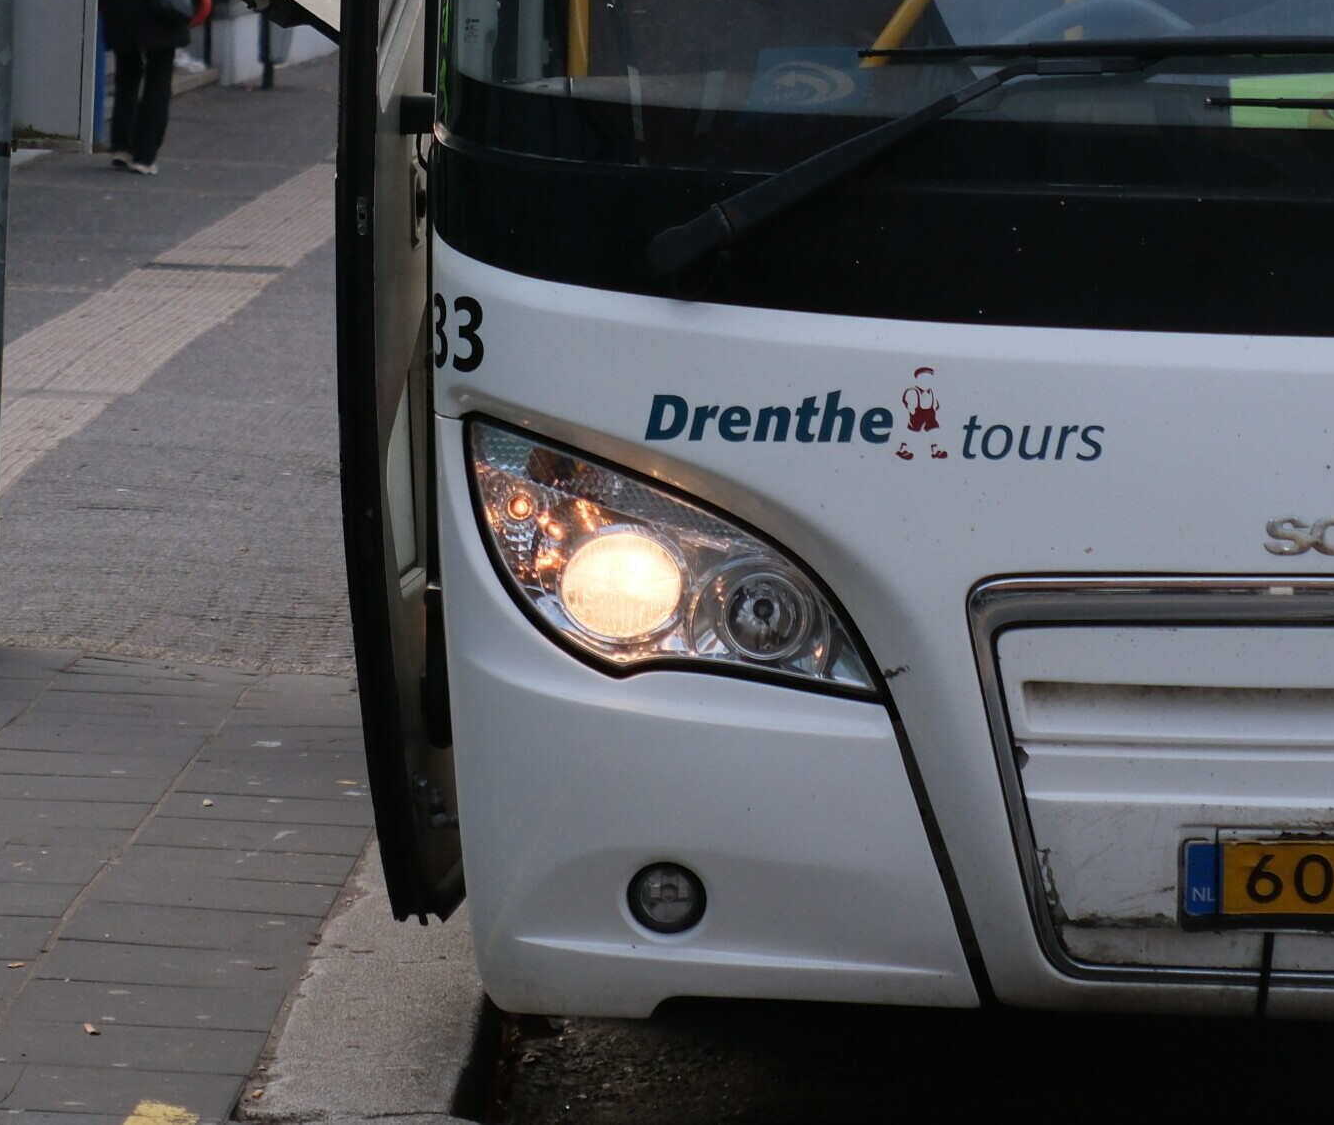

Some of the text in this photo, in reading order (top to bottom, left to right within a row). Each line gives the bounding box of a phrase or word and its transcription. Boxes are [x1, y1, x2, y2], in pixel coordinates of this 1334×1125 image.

[644, 389, 1105, 462] Drenthe tours
[1191, 886, 1217, 903] NL
